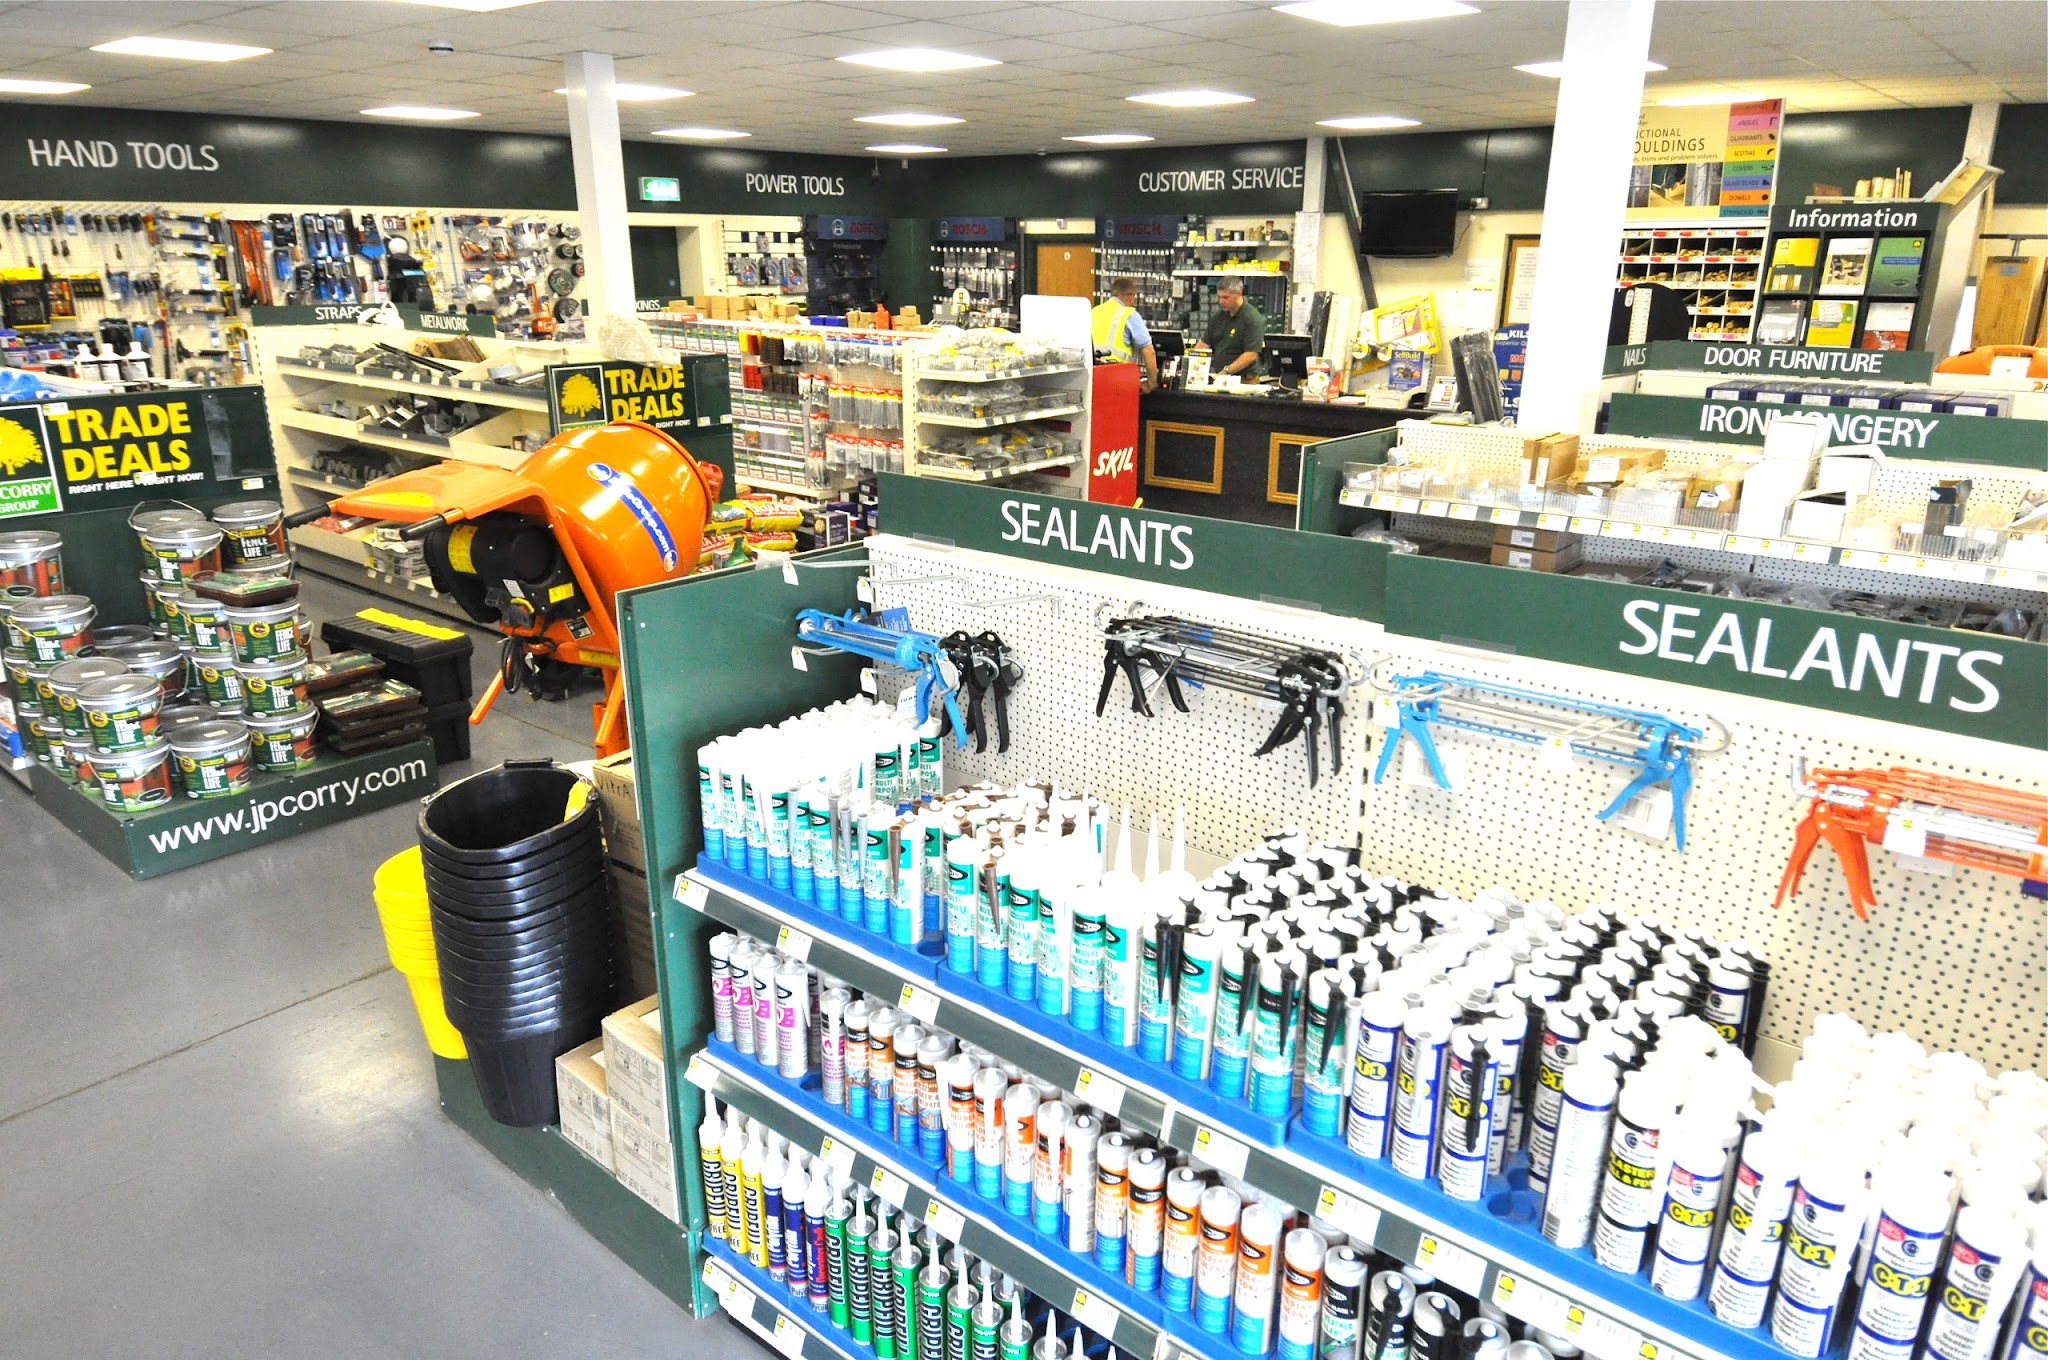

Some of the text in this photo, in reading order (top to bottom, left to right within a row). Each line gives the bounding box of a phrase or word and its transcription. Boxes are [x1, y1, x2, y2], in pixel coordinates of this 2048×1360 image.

[28, 138, 220, 173] HAND TOOLS
[1671, 154, 1696, 162] problem
[746, 173, 845, 196] POWER TOOLS
[1138, 166, 1304, 192] CUSTOMER SERVICE
[953, 224, 987, 235] BOSCH
[1788, 208, 1918, 228] Information
[315, 306, 362, 321] STRAPS
[420, 314, 469, 332] METALWORK
[1623, 348, 1647, 367] NAILS
[1704, 346, 1884, 374] DOOR FURNITURE
[604, 364, 685, 396] TRADE
[611, 392, 685, 421] DEALS
[47, 402, 192, 444] TRADE
[1699, 404, 1940, 449] IRONNGERY
[62, 439, 192, 482] DEALS
[1093, 446, 1133, 479] SKIL
[69, 482, 104, 495] RIGHT
[105, 480, 135, 491] HERE
[177, 472, 204, 483] NOW!
[241, 537, 268, 548] FENCE
[1001, 499, 1195, 571] SEALANTS
[243, 546, 262, 558] LIFE
[277, 640, 291, 653] LIFE
[1619, 599, 2004, 713] SEALANTS
[273, 697, 290, 709] LIFE
[272, 751, 288, 763] LIFE
[148, 759, 428, 854] www.jpcorry.com
[702, 1160, 725, 1218] GRIPFILL
[724, 1174, 741, 1231] GRIPFILL
[744, 1187, 761, 1245] GRIPFILL
[827, 1234, 845, 1305] GRIPFILL
[848, 1252, 871, 1321] GRIPFILL
[871, 1266, 895, 1338] GRIPFILL
[893, 1281, 910, 1355] GRIPFILL
